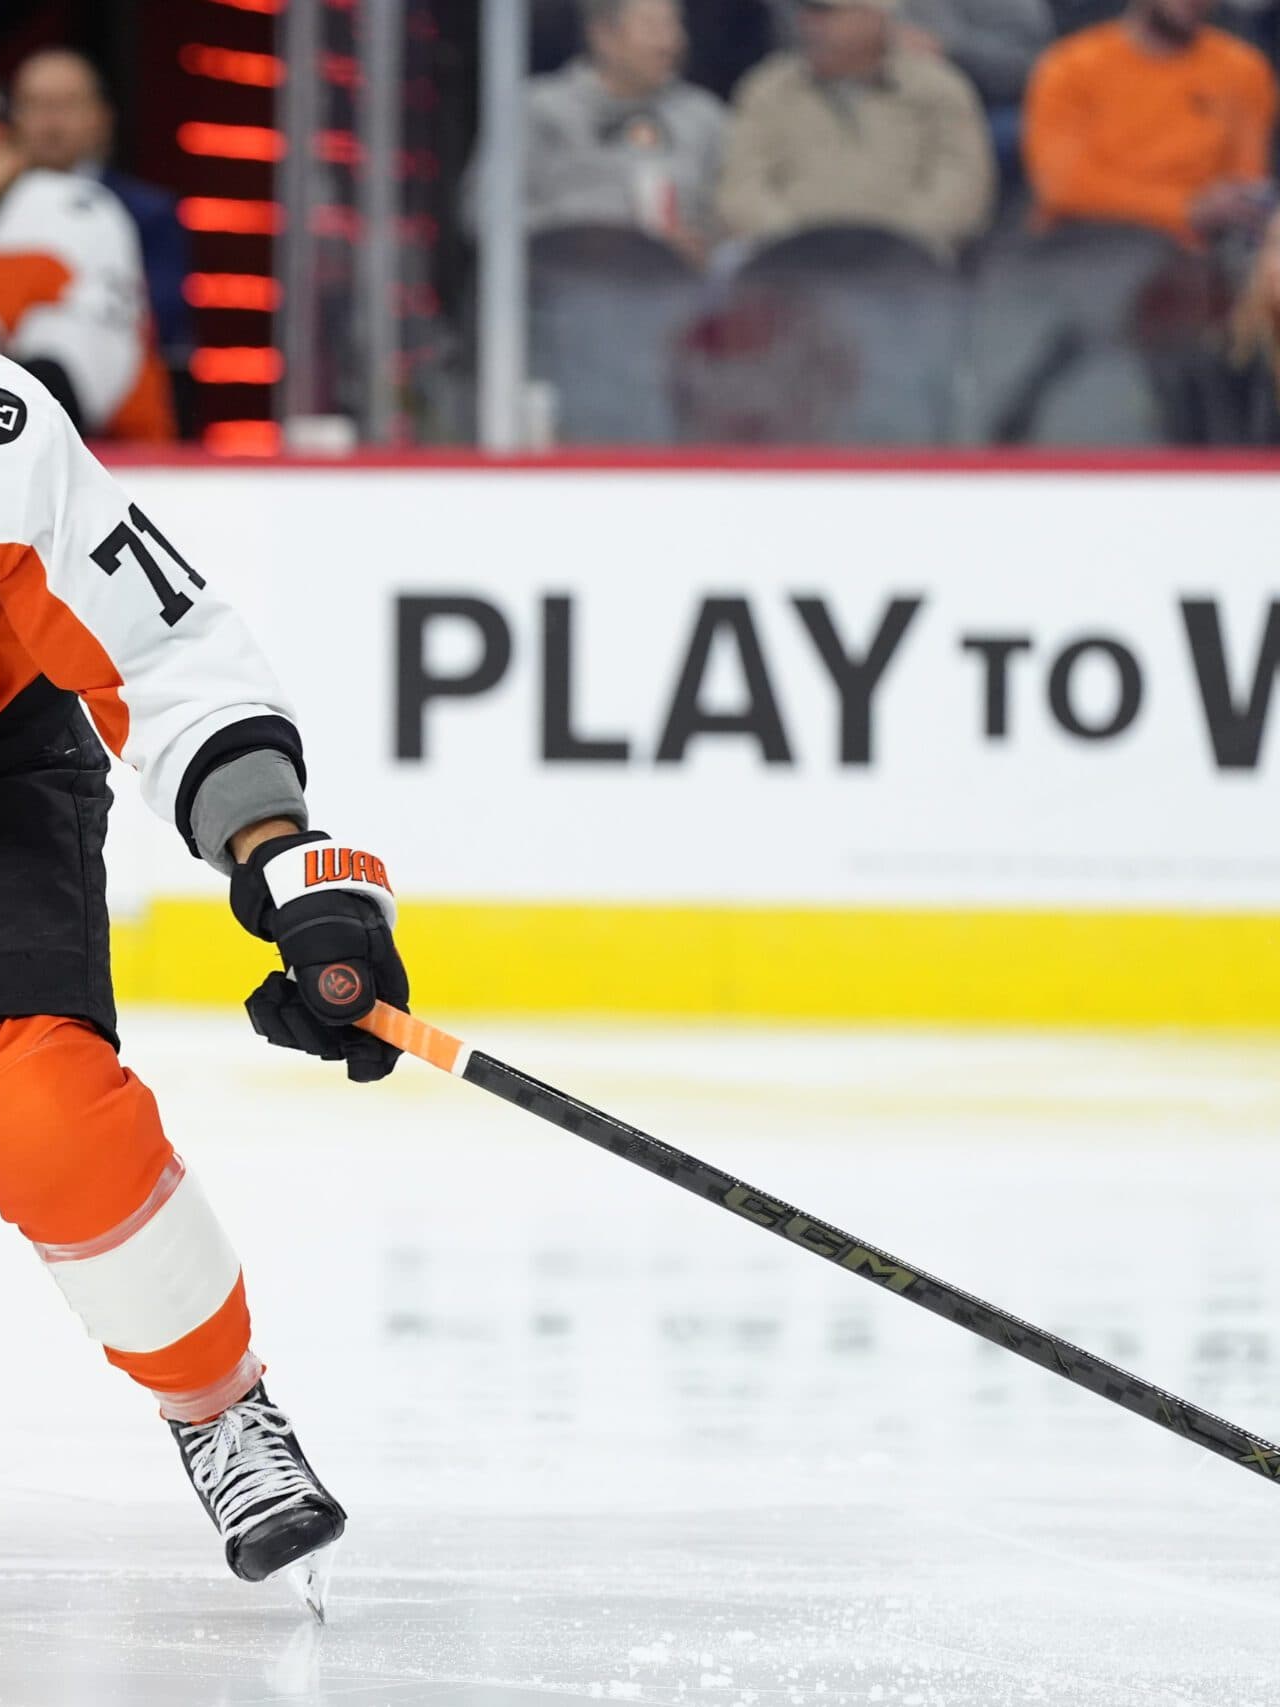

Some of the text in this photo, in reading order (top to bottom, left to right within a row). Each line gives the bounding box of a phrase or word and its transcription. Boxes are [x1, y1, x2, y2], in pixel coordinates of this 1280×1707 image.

[89, 501, 207, 628] 71
[393, 595, 923, 764] PLAY
[960, 634, 1144, 742] TO
[723, 1184, 920, 1294] CCM
